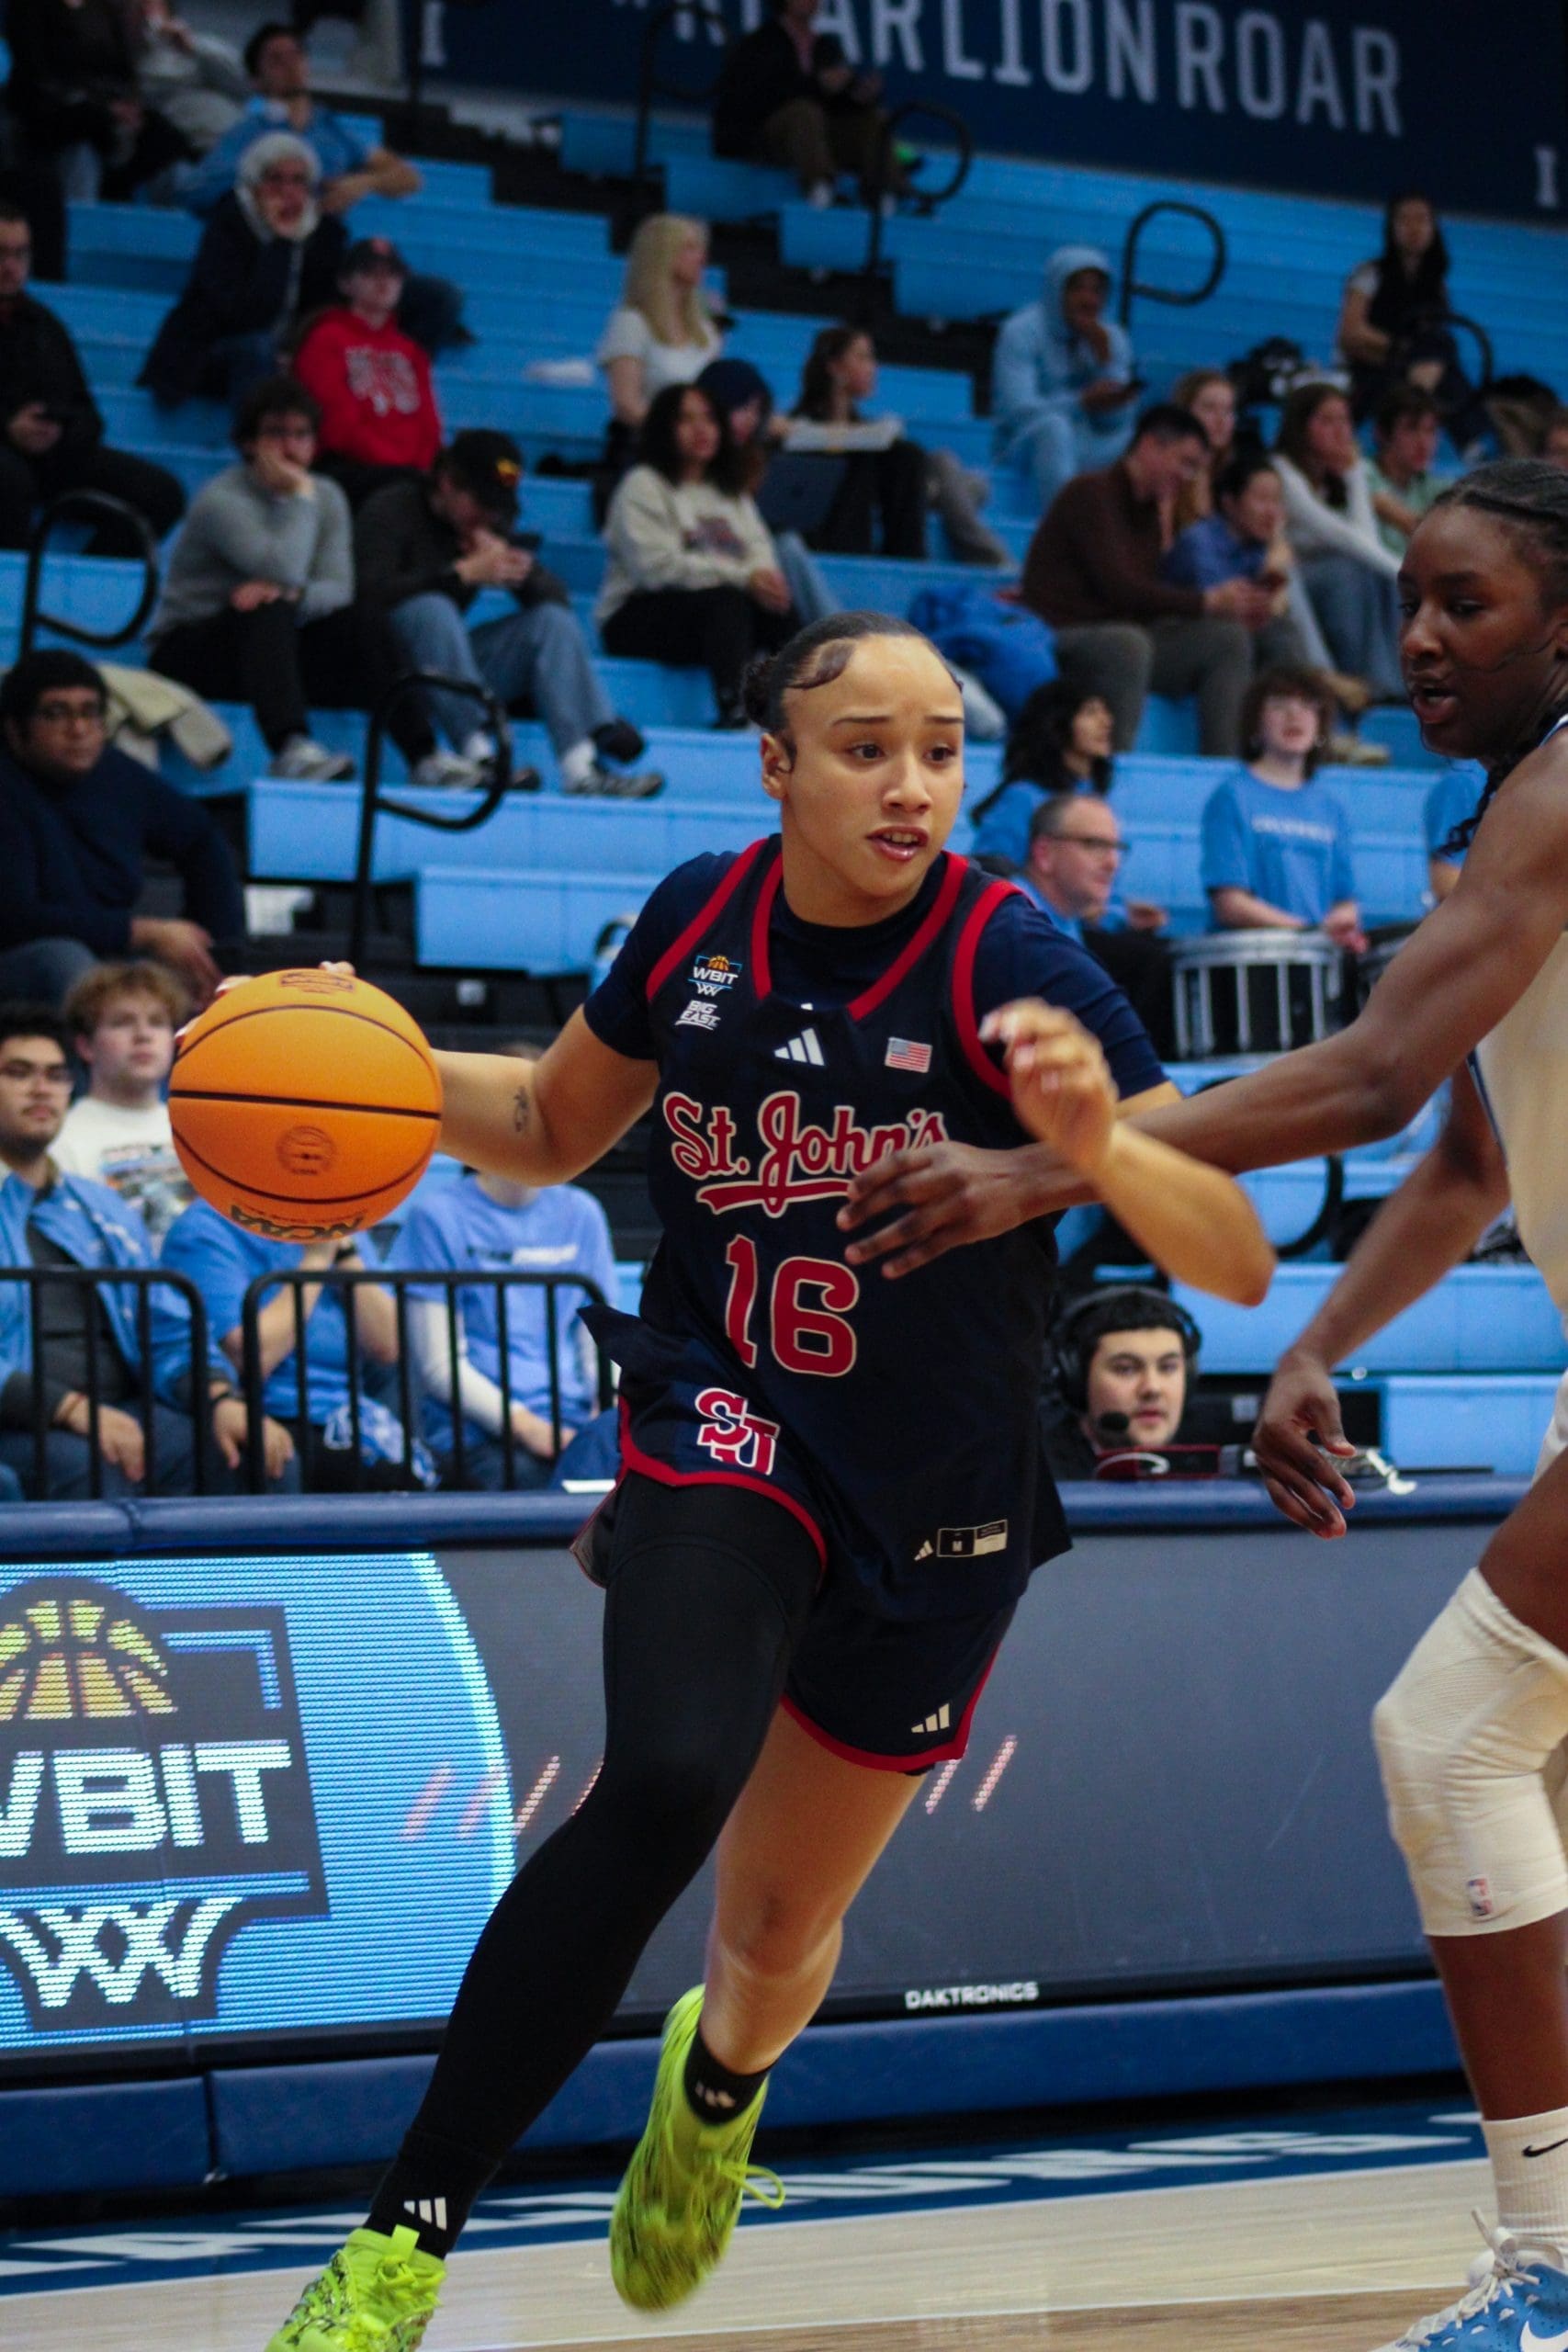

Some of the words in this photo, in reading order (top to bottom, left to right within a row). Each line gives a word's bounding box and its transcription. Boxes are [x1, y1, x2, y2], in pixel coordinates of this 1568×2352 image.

[694, 966, 739, 985] WBIT
[680, 1011, 721, 1027] EAST
[688, 1000, 718, 1015] BIG
[663, 1091, 750, 1180] St.
[726, 1234, 859, 1377] 16
[905, 1981, 1039, 2010] DAKTRONICS
